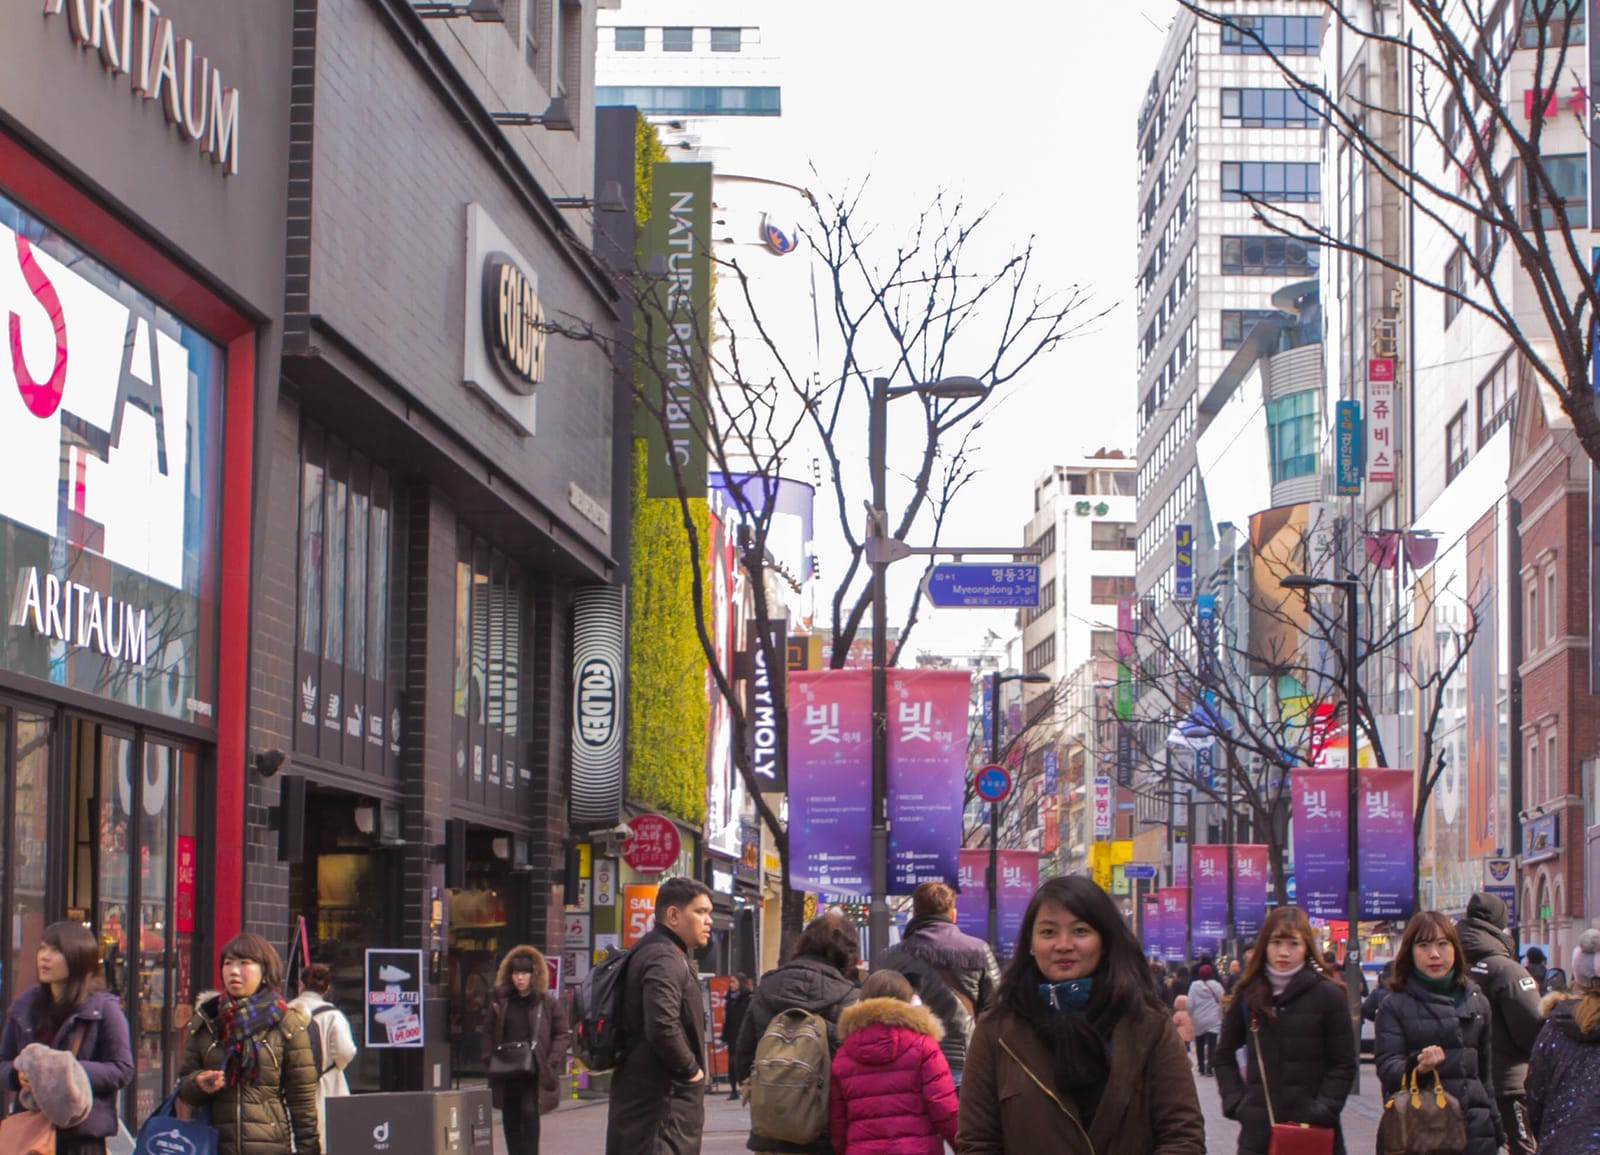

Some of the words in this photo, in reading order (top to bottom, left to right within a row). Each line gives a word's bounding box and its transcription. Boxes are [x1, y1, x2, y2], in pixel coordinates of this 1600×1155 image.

[667, 192, 694, 312] NATURE
[500, 262, 546, 384] FOLDER
[1372, 400, 1390, 467] 쥬비스
[992, 568, 1036, 582] 명동3길
[952, 585, 1012, 596] Myeongdong
[1015, 585, 1036, 596] 3-gil
[18, 566, 147, 665] ARITAUM
[581, 662, 613, 745] FOLDER
[806, 703, 841, 744] 빛
[898, 701, 932, 743] 빛
[1303, 790, 1327, 819] 빛
[1366, 790, 1390, 819] 빛
[1003, 866, 1021, 887] 빛
[1200, 858, 1215, 877] 빛
[1237, 858, 1253, 877] 빛
[629, 897, 656, 910] SAL
[398, 992, 417, 1003] SALE
